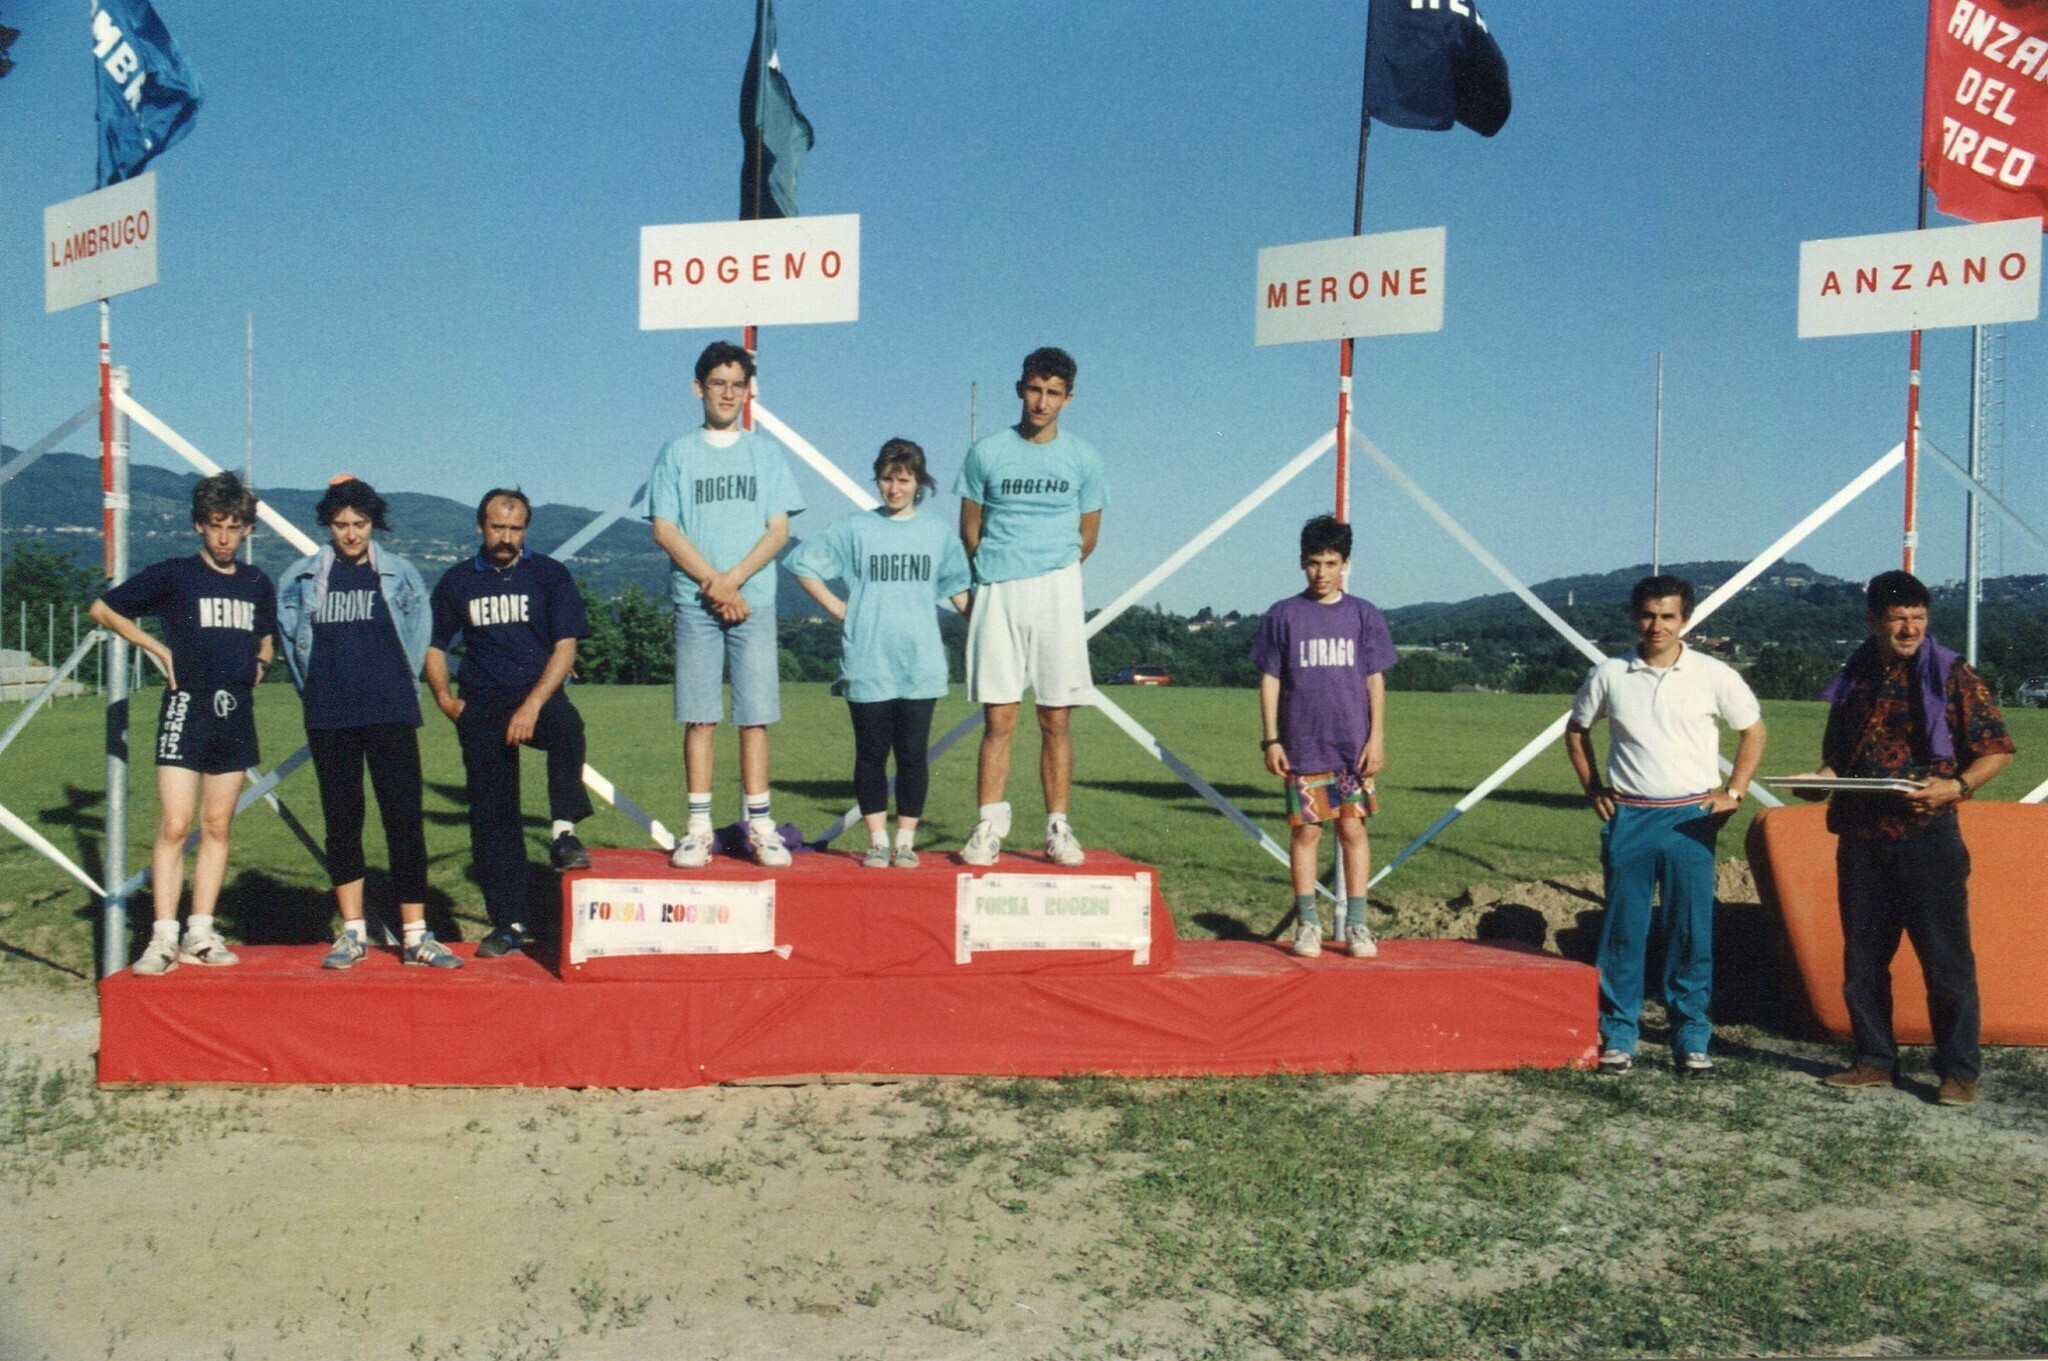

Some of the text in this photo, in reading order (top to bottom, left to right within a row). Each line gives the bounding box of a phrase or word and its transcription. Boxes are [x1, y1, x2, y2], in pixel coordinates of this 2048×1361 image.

[1947, 0, 2048, 83] ANZA
[1955, 67, 2017, 126] DEL
[51, 209, 149, 268] LAMBRUGO
[653, 250, 842, 287] ROGENO
[1820, 252, 2027, 297] ANZANO
[1266, 266, 1428, 309] MERONE
[695, 474, 758, 505] ROGENO
[1001, 478, 1070, 496] ROGENO
[869, 553, 931, 582] ROGENO
[199, 597, 256, 632] MERONE
[469, 593, 530, 627] MERONE
[1300, 637, 1355, 668] LURAGO
